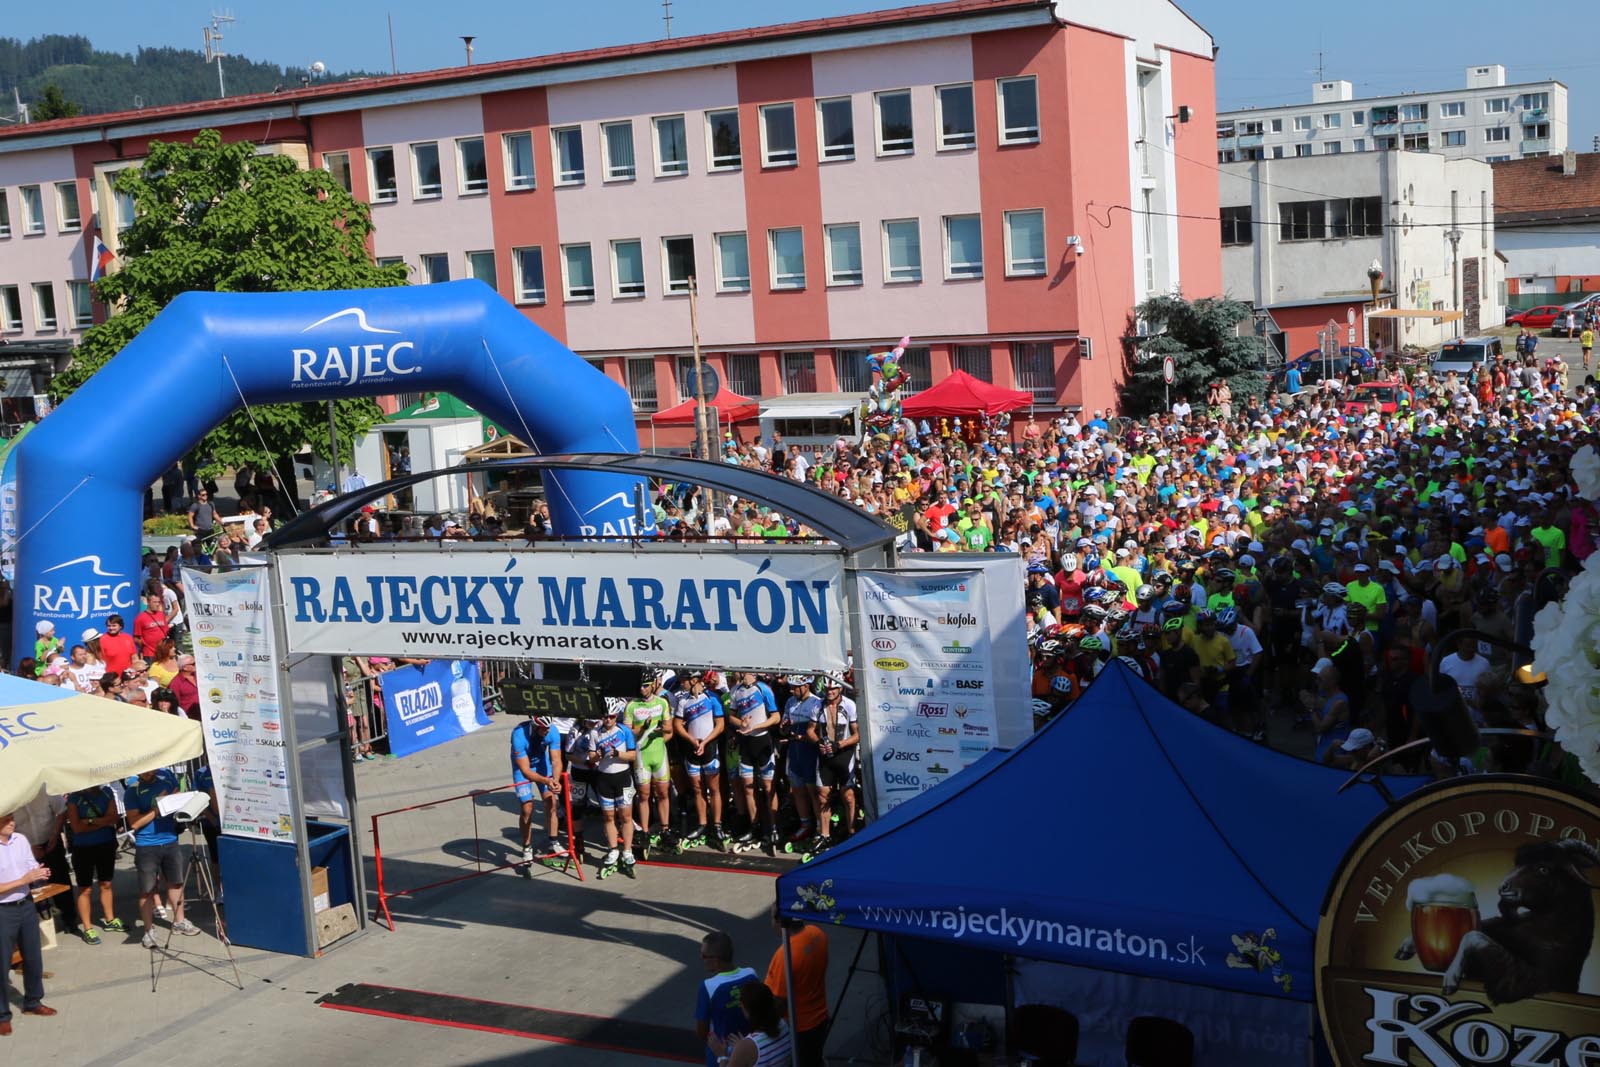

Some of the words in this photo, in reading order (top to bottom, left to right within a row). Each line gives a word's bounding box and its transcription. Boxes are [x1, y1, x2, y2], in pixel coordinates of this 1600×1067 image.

[292, 341, 416, 386] RAJEC
[33, 582, 132, 620] RAJEC
[290, 557, 524, 626] RAJECKÝ
[538, 558, 830, 634] MARATÓN
[946, 613, 977, 629] kofola
[402, 629, 664, 651] www.rajeckymaraton.sk
[875, 640, 893, 649] KIA
[956, 679, 985, 689] BASF
[219, 711, 240, 720] asics
[906, 728, 932, 739] RAJEC
[895, 750, 920, 761] asics
[884, 770, 920, 786] beko
[858, 904, 1207, 967] www.rajeckymaraton.sk
